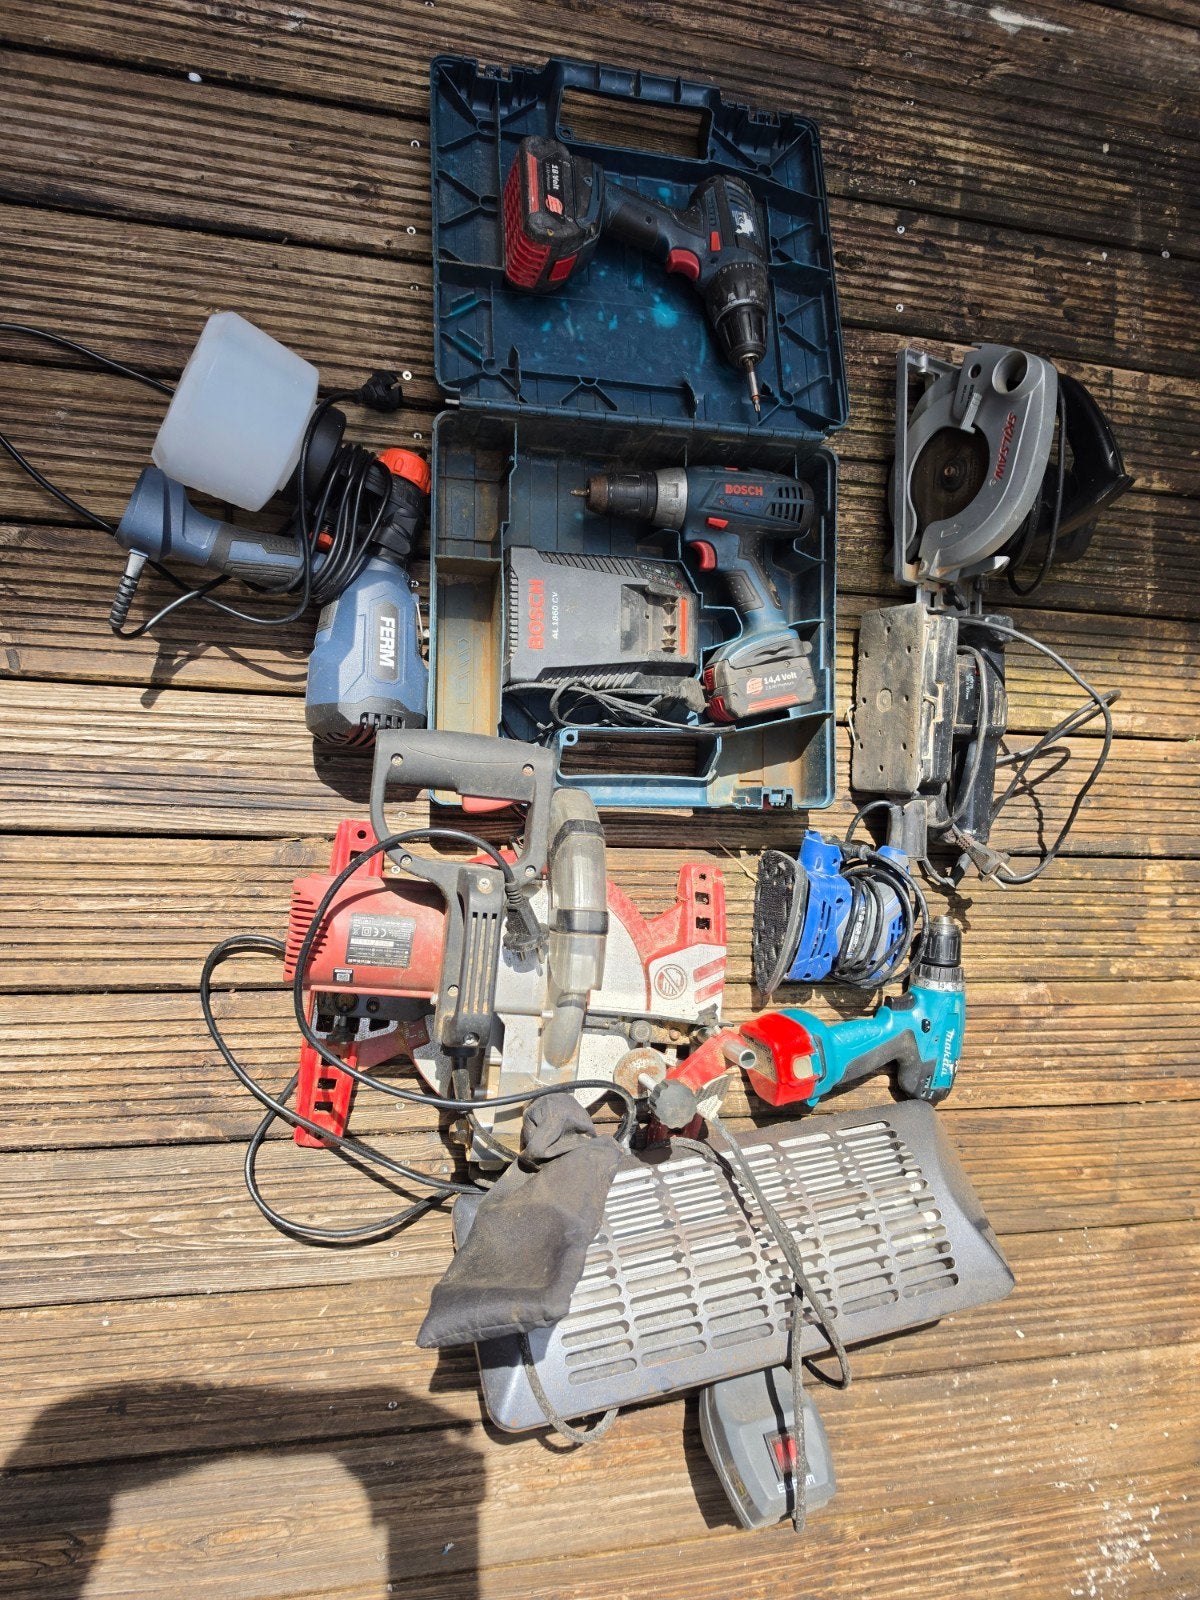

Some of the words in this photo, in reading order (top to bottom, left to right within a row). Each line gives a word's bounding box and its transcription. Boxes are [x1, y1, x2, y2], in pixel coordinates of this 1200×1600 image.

[552, 175, 560, 190] Volt
[994, 411, 1017, 480] SKILSAW
[725, 484, 763, 496] BOSCH
[528, 578, 545, 649] BOSCH
[379, 616, 395, 667] FERM
[763, 674, 781, 684] 14,4
[781, 671, 797, 681] Volt
[941, 1029, 955, 1077] makita
